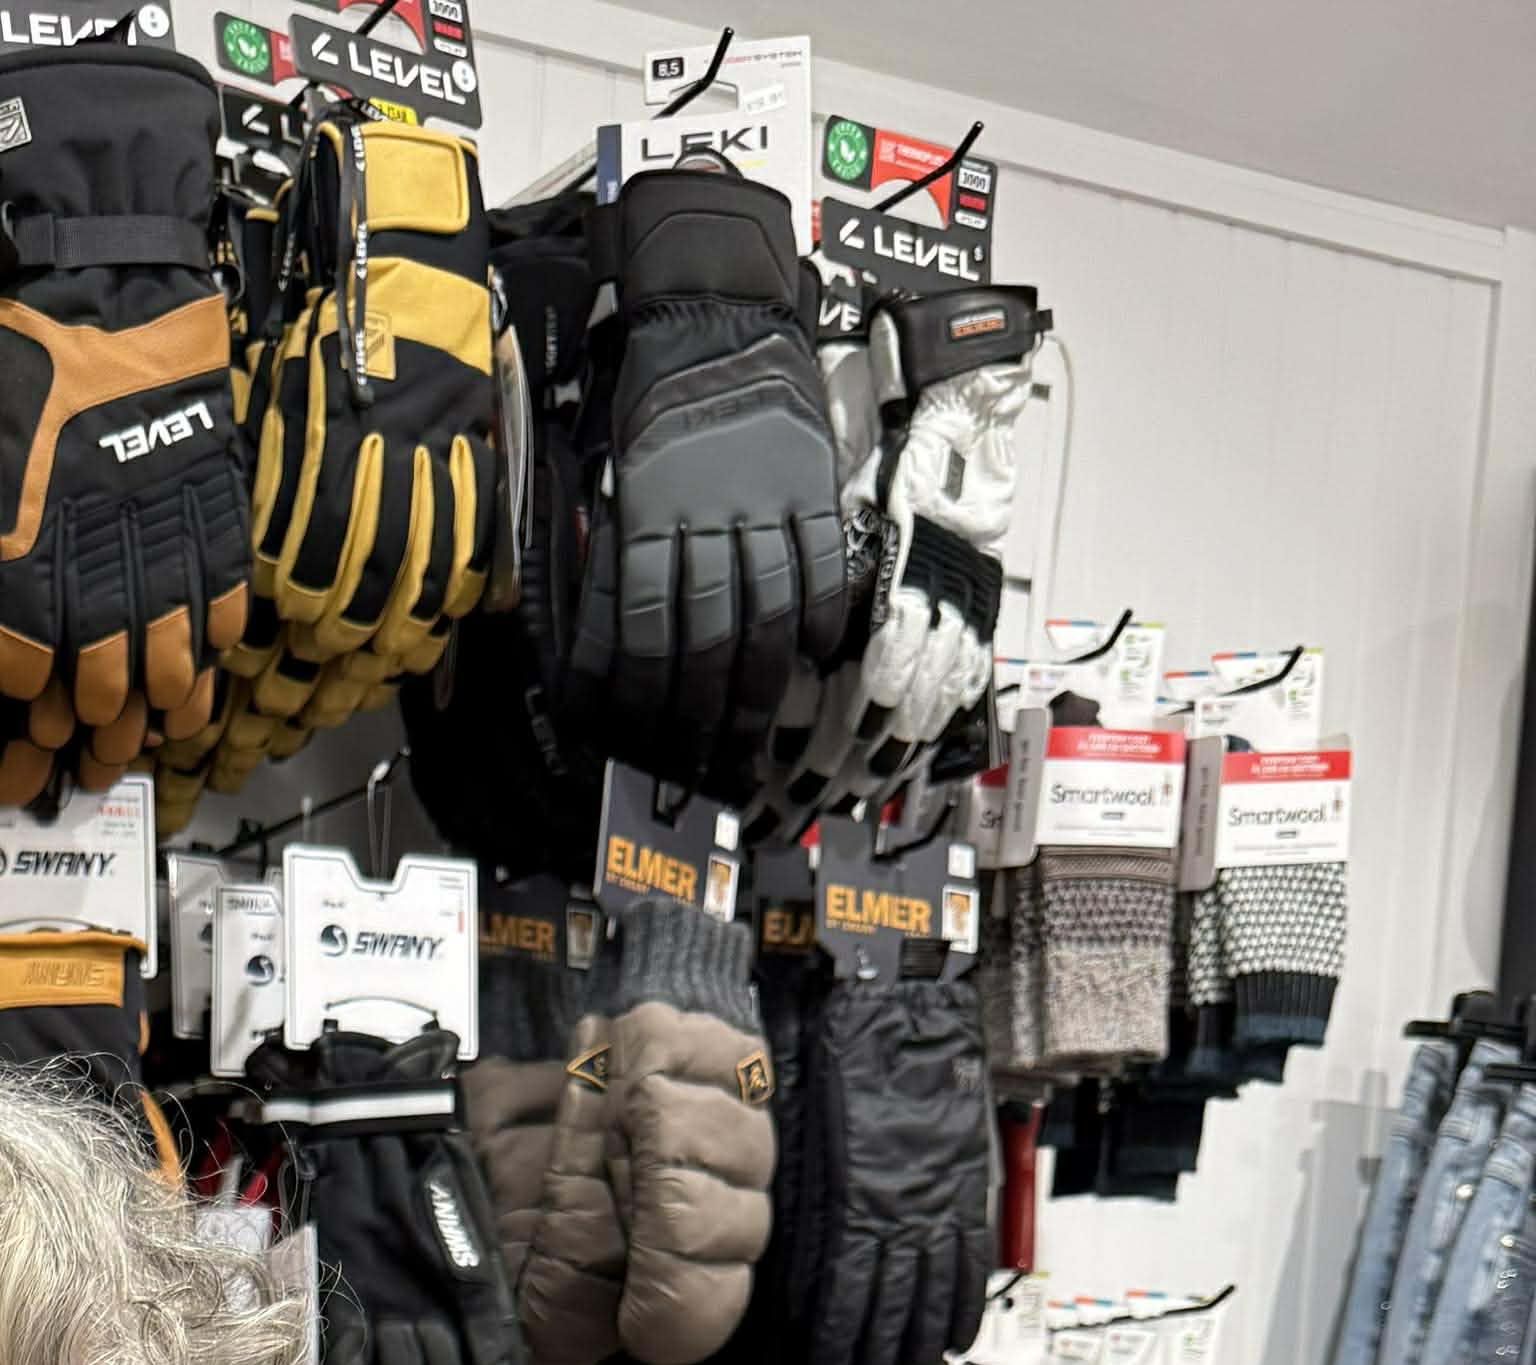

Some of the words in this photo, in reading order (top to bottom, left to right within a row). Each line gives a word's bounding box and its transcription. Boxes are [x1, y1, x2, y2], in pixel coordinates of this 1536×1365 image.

[348, 41, 466, 105] LEVEL
[641, 126, 768, 161] LEKI
[873, 225, 980, 282] LEVEL
[98, 401, 214, 463] LEVEL
[1050, 784, 1156, 806] Smartwool
[1227, 807, 1327, 827] Smartwool
[13, 851, 117, 876] SWANY
[606, 834, 699, 904] ELMER
[825, 883, 932, 935] ELMER
[353, 931, 446, 962] SWANY
